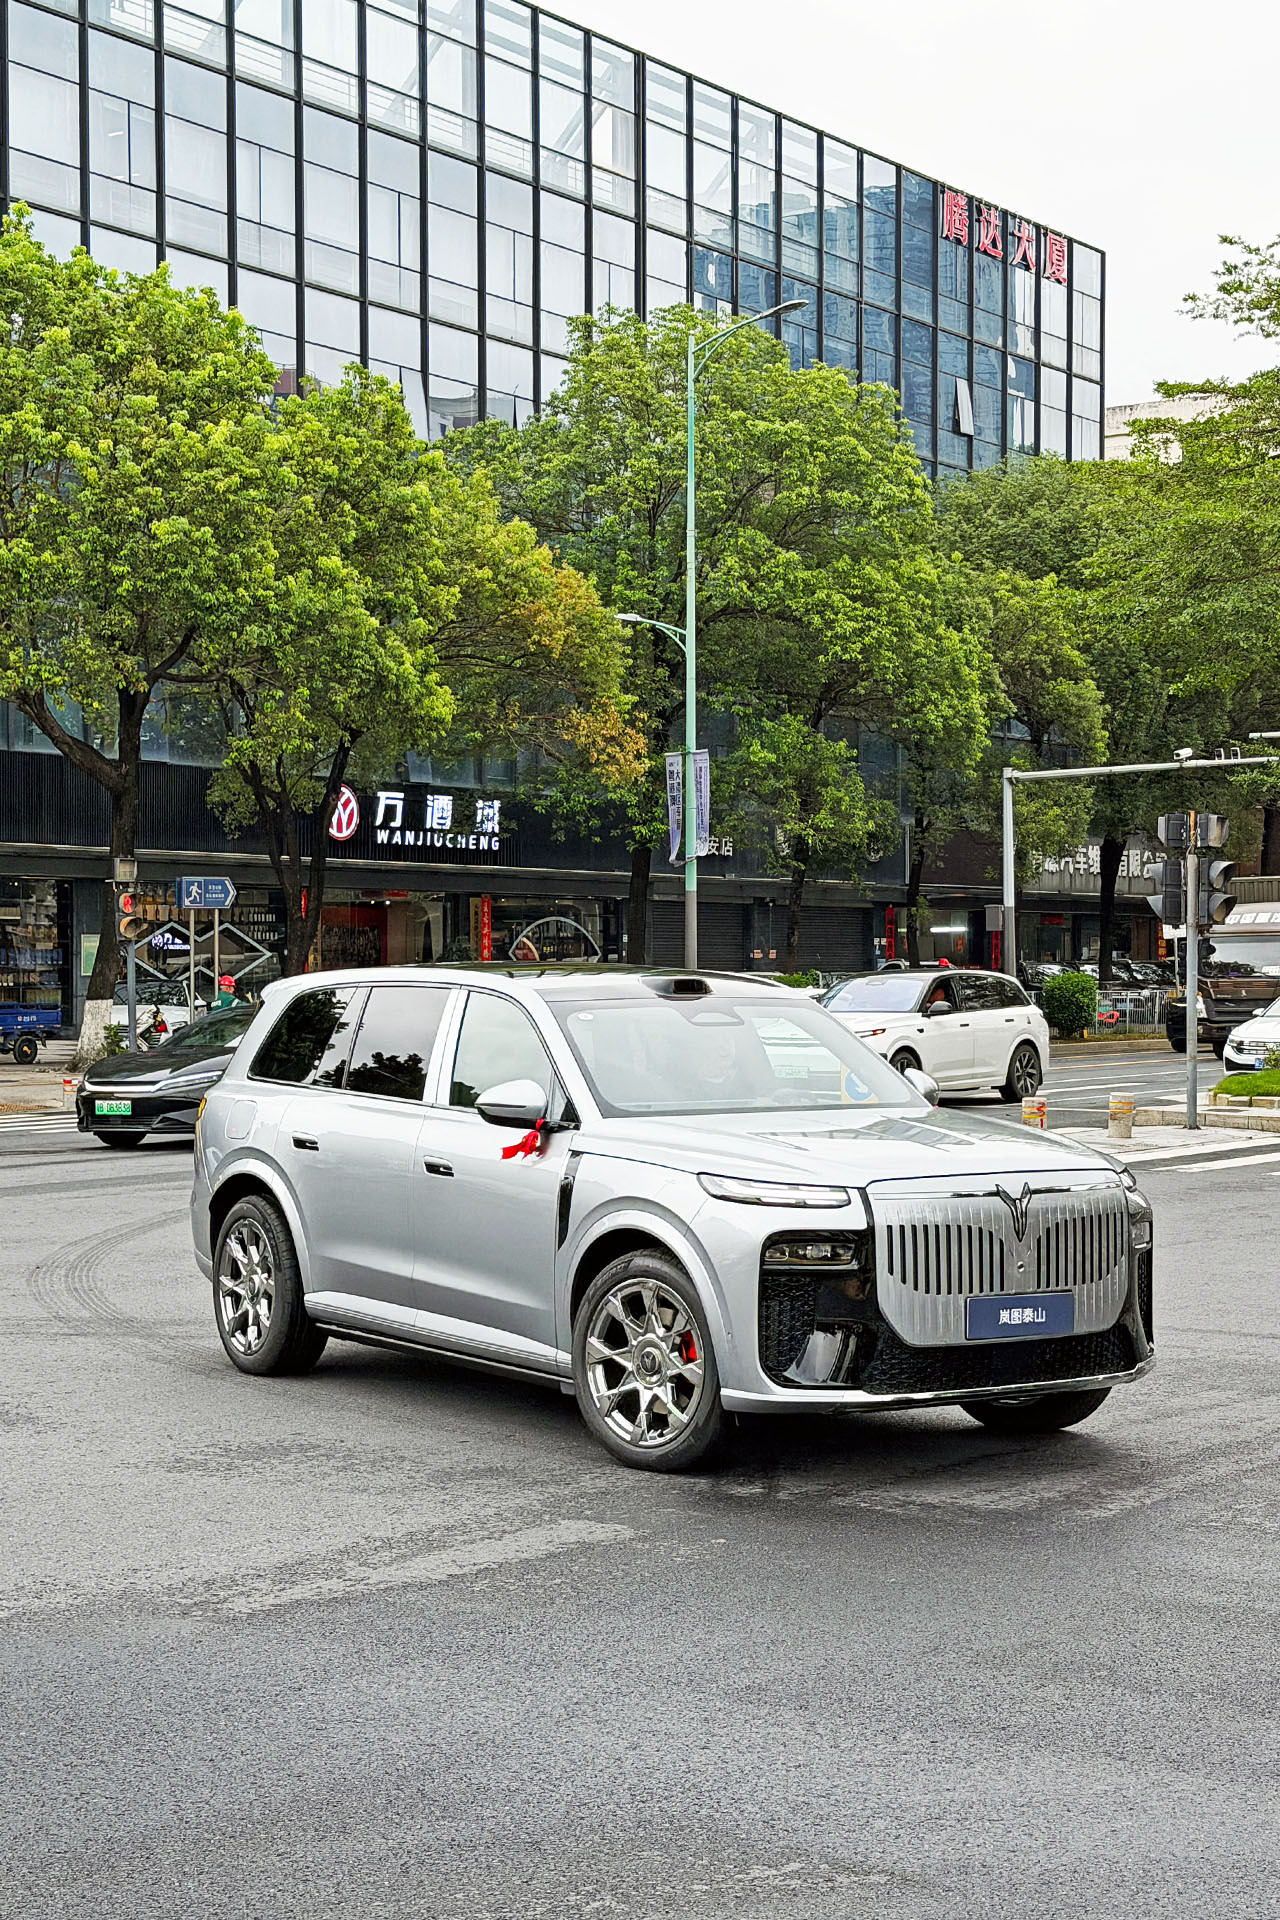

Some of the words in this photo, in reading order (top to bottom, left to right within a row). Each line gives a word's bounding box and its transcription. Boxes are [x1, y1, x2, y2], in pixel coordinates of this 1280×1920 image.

[941, 190, 1068, 284] 腾达大厦
[377, 829, 500, 851] WANJIUCHENG
[998, 1306, 1046, 1325] 岚图泰山
